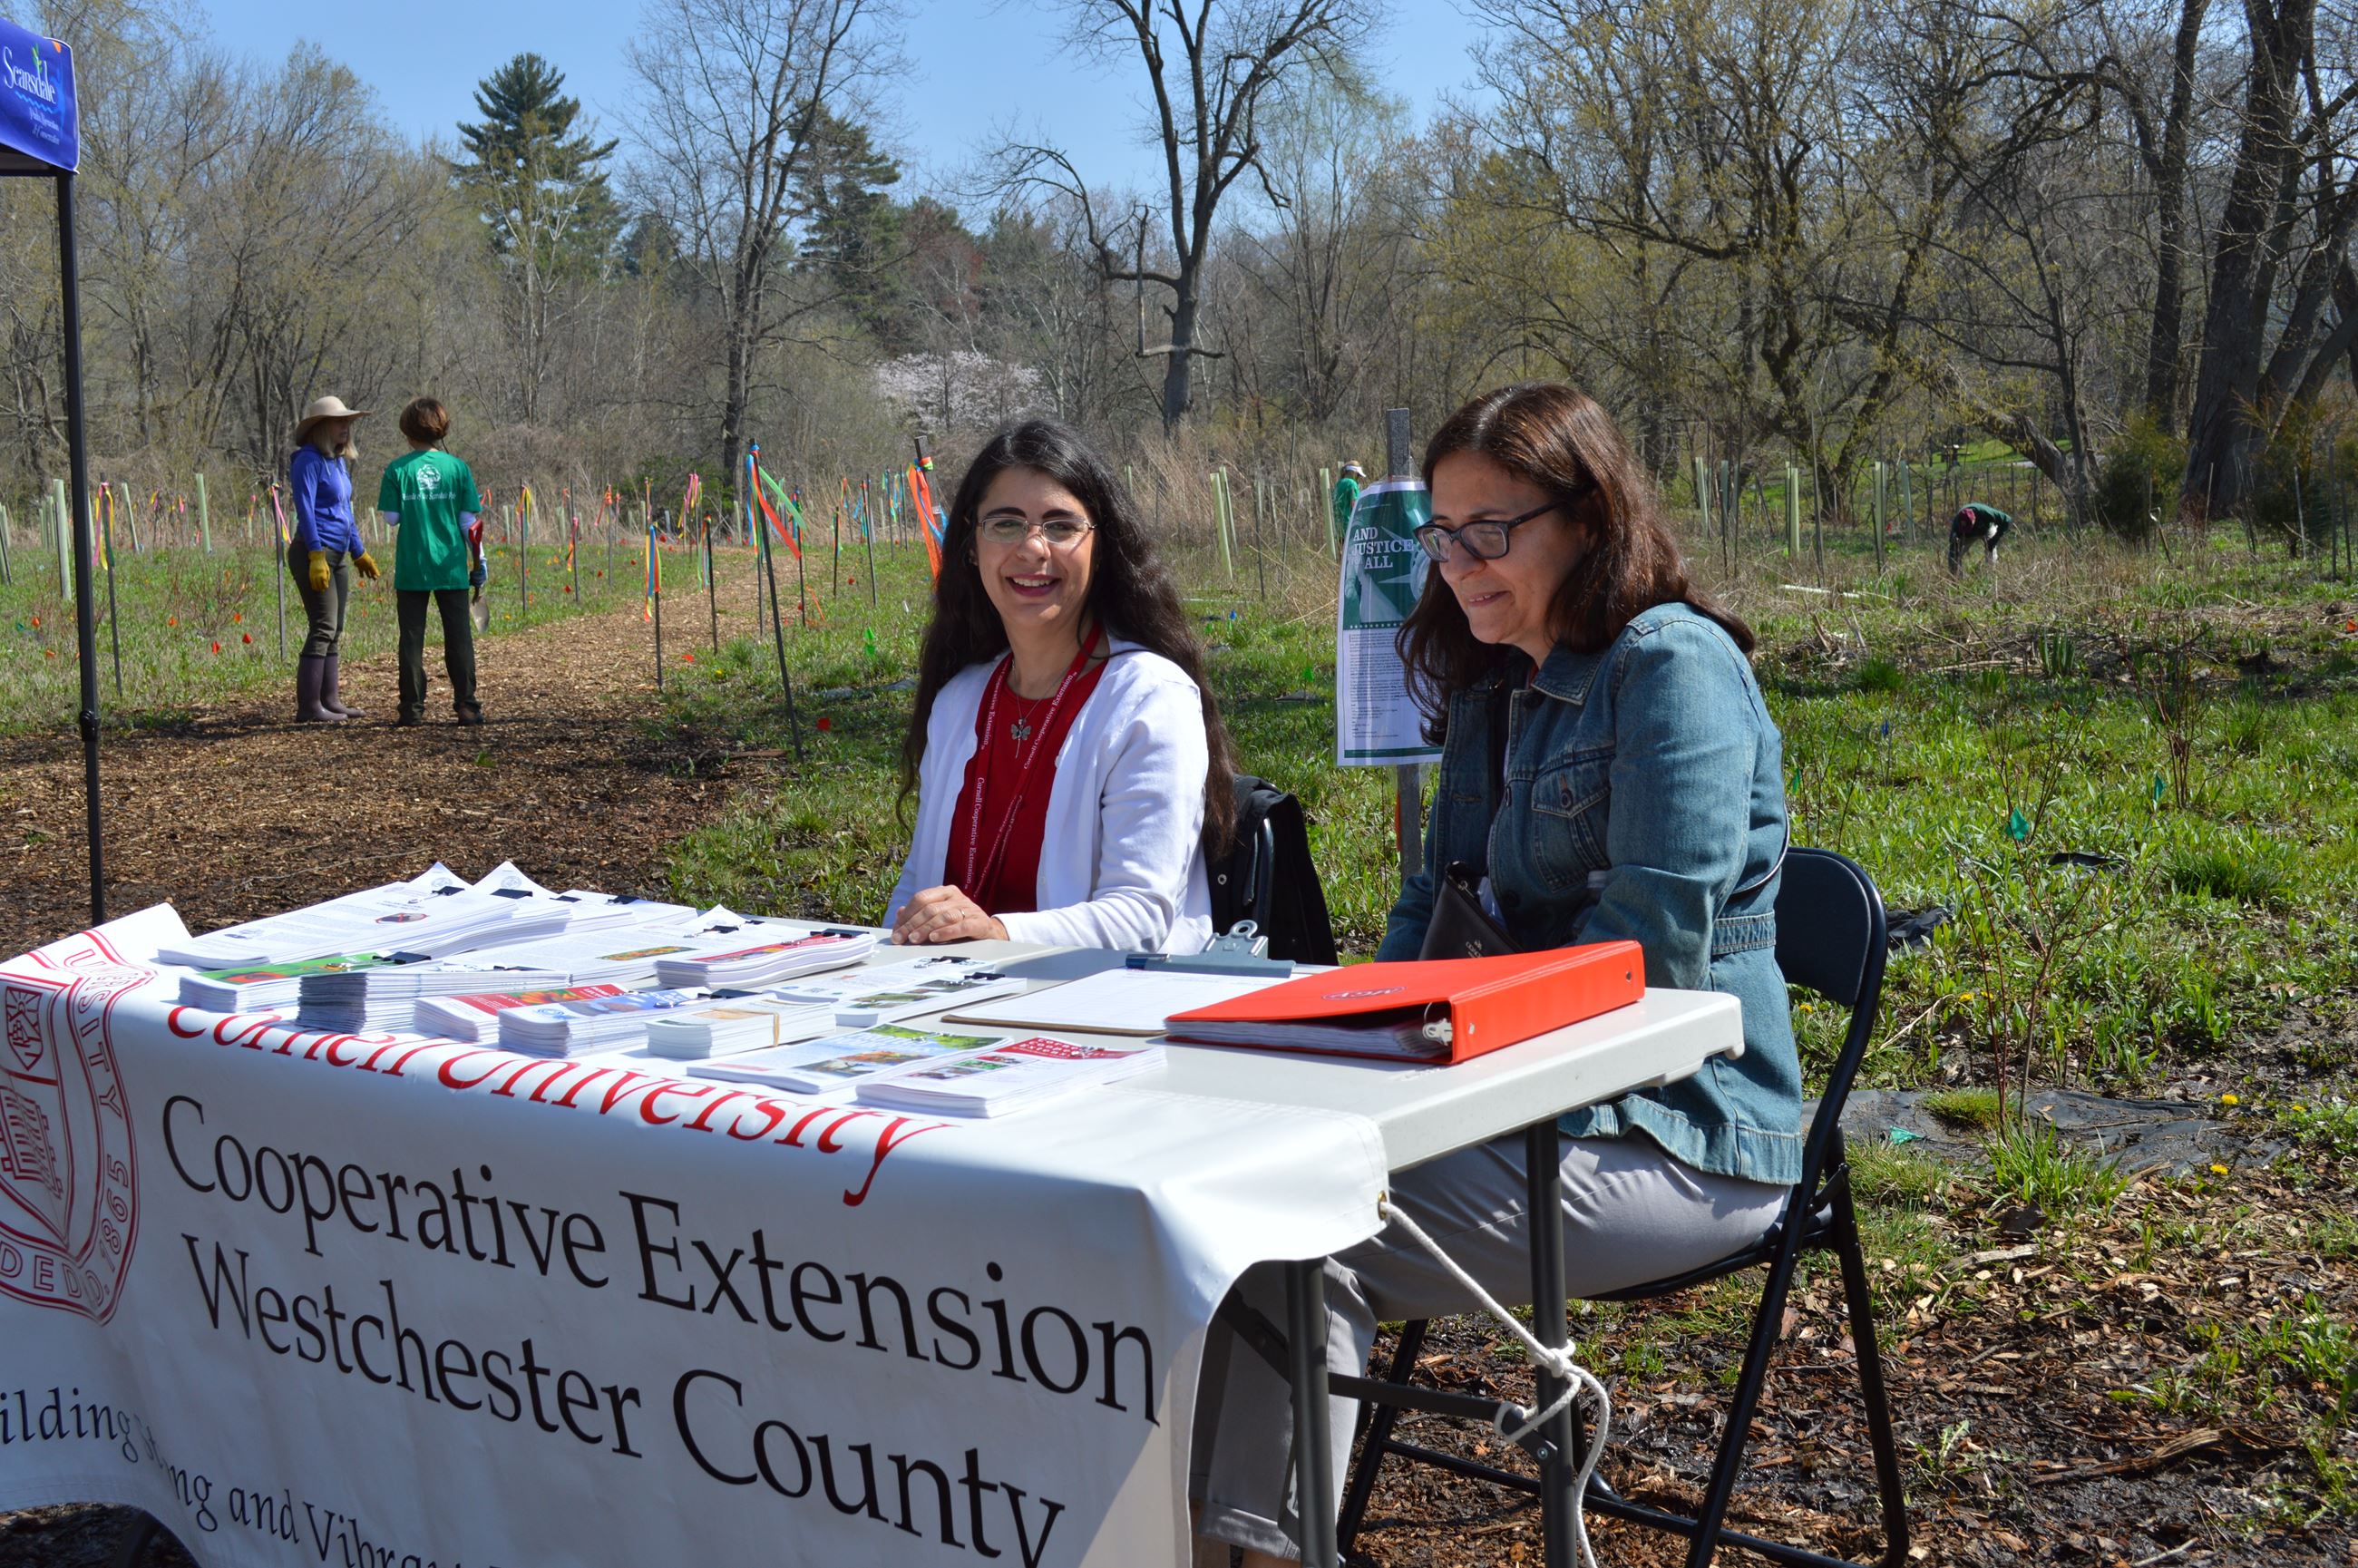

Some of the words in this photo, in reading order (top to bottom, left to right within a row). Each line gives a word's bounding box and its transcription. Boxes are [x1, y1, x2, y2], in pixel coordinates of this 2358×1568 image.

[4, 46, 56, 104] Scarsdale
[1352, 540, 1414, 556] JUSTICE
[1353, 527, 1379, 541] AND
[1364, 556, 1393, 570] ALL
[983, 711, 996, 745] Extension
[1023, 745, 1038, 770] Cornell
[1034, 707, 1057, 745] Cooperative
[1051, 675, 1075, 706] Extension
[975, 777, 985, 803] Cornell
[970, 803, 982, 846] Cooperative
[966, 847, 977, 884] Extension
[98, 1154, 130, 1272] 1865
[163, 1096, 609, 1289] Cooperative
[619, 1190, 1161, 1428] Extension
[181, 1232, 643, 1459] Westchester
[229, 1487, 300, 1544] and
